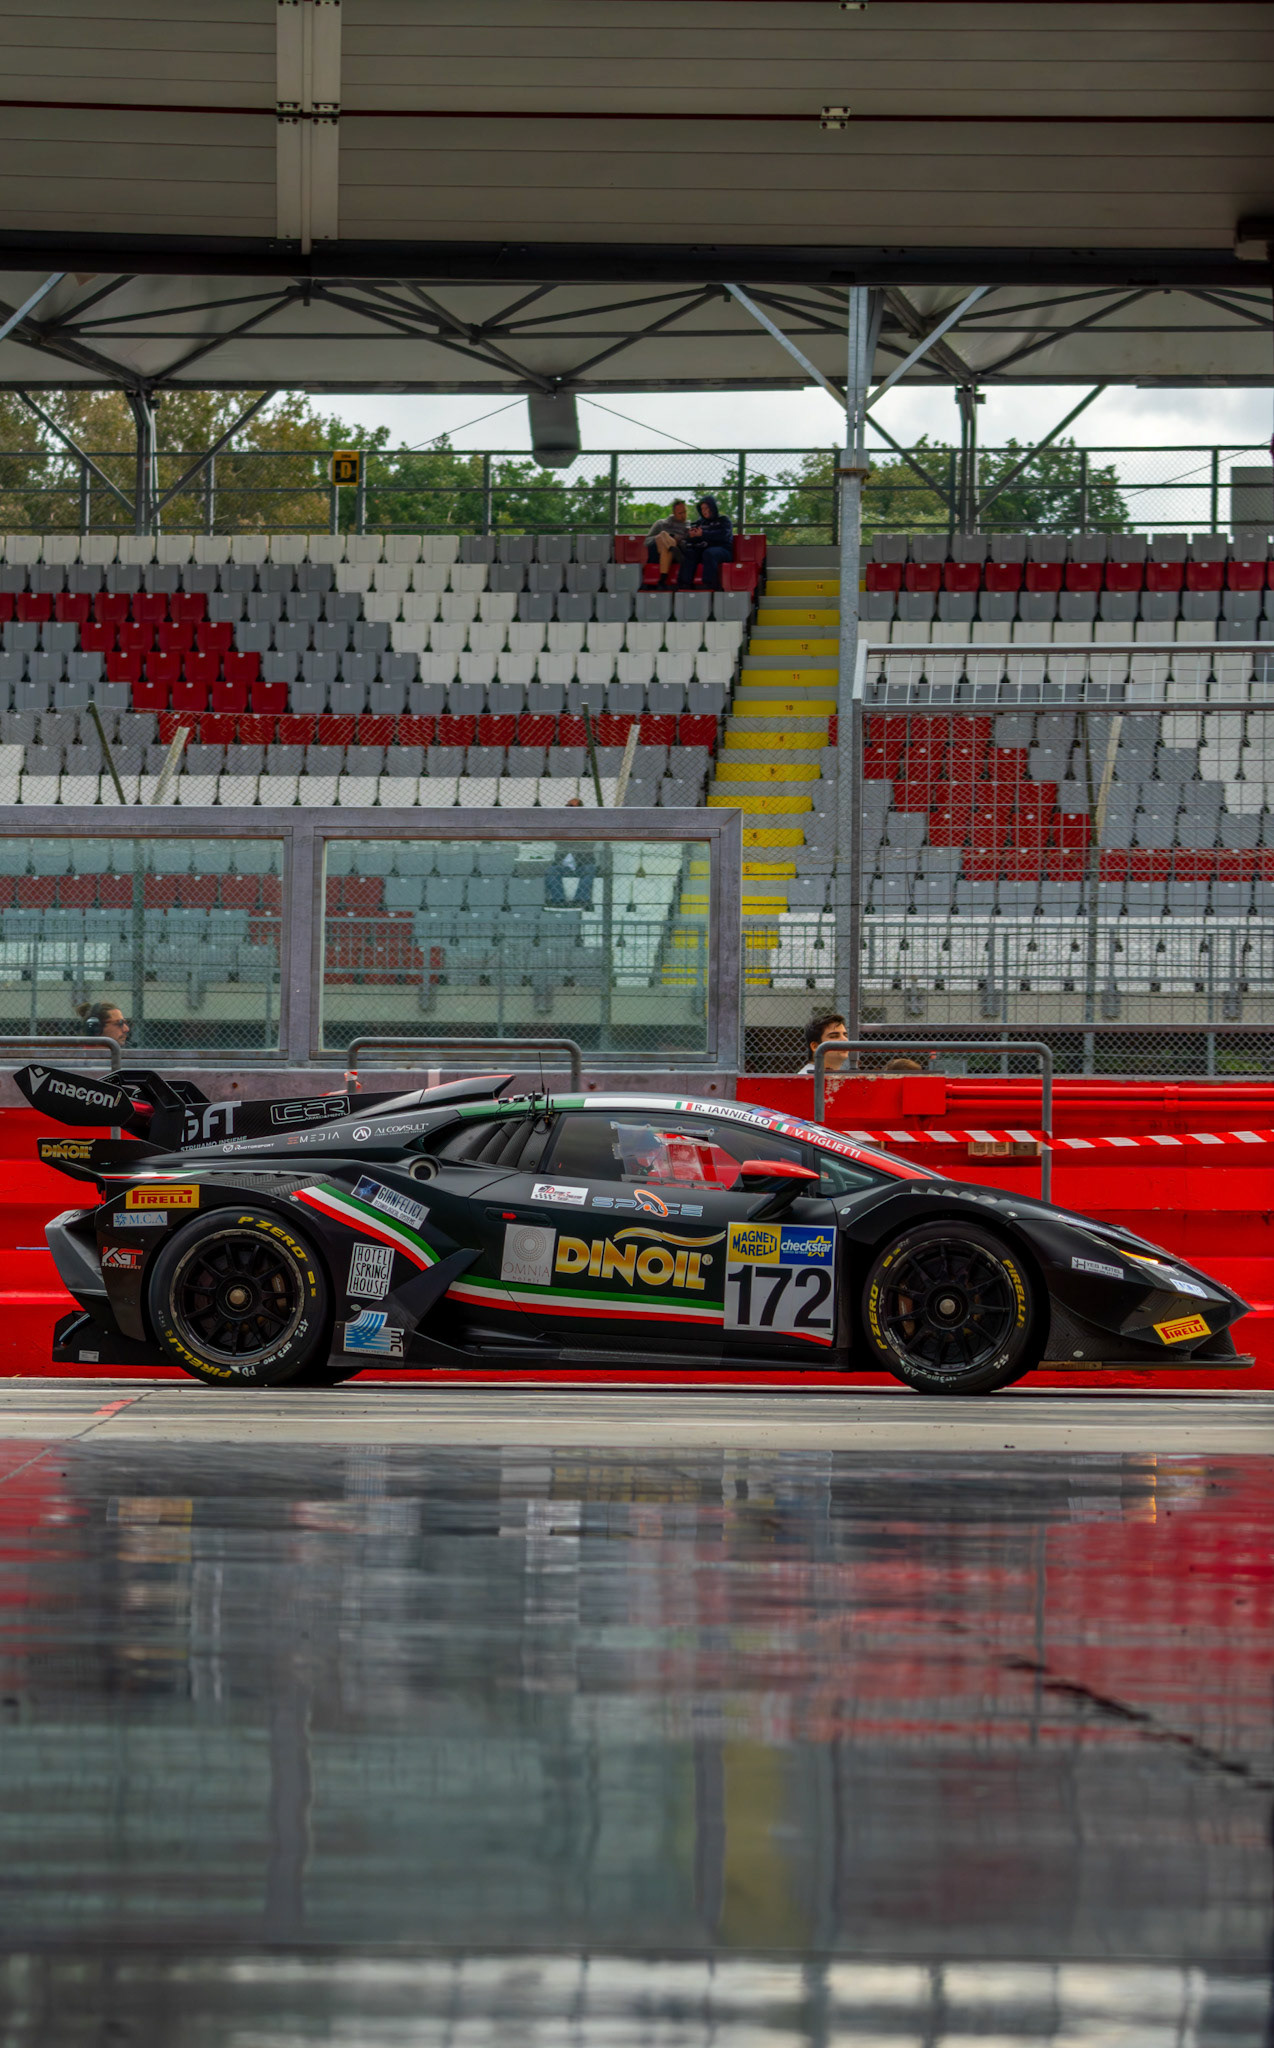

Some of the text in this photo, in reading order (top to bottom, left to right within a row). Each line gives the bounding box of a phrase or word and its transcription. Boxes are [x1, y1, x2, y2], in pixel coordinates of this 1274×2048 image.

[340, 461, 352, 479] D
[800, 643, 808, 651] 12
[48, 1078, 115, 1109] macron
[694, 1103, 770, 1126] R. IANNIELLO
[41, 1143, 92, 1160] DINOIL
[794, 1128, 861, 1159] V. VIGLIETTI
[132, 1189, 193, 1205] PIRELLI
[377, 1186, 423, 1220] GIANFELICI
[592, 1196, 704, 1217] SPACE
[129, 1213, 167, 1225] M.C.A.
[237, 1215, 308, 1259] P ZERO
[733, 1230, 778, 1246] MAGNETI
[781, 1239, 833, 1254] checkstar
[357, 1246, 388, 1266] HOTEL
[733, 1242, 778, 1257] MARELLI
[355, 1262, 388, 1281] SPRING
[503, 1261, 550, 1278] OMNIA
[554, 1236, 707, 1291] DINOIL
[352, 1276, 386, 1296] HOUSE
[1001, 1258, 1027, 1323] PIRELLI
[727, 1264, 833, 1329] 172
[868, 1283, 888, 1350] P ZERO
[1160, 1319, 1205, 1340] PIRELLI
[168, 1337, 233, 1378] PIRELLI
